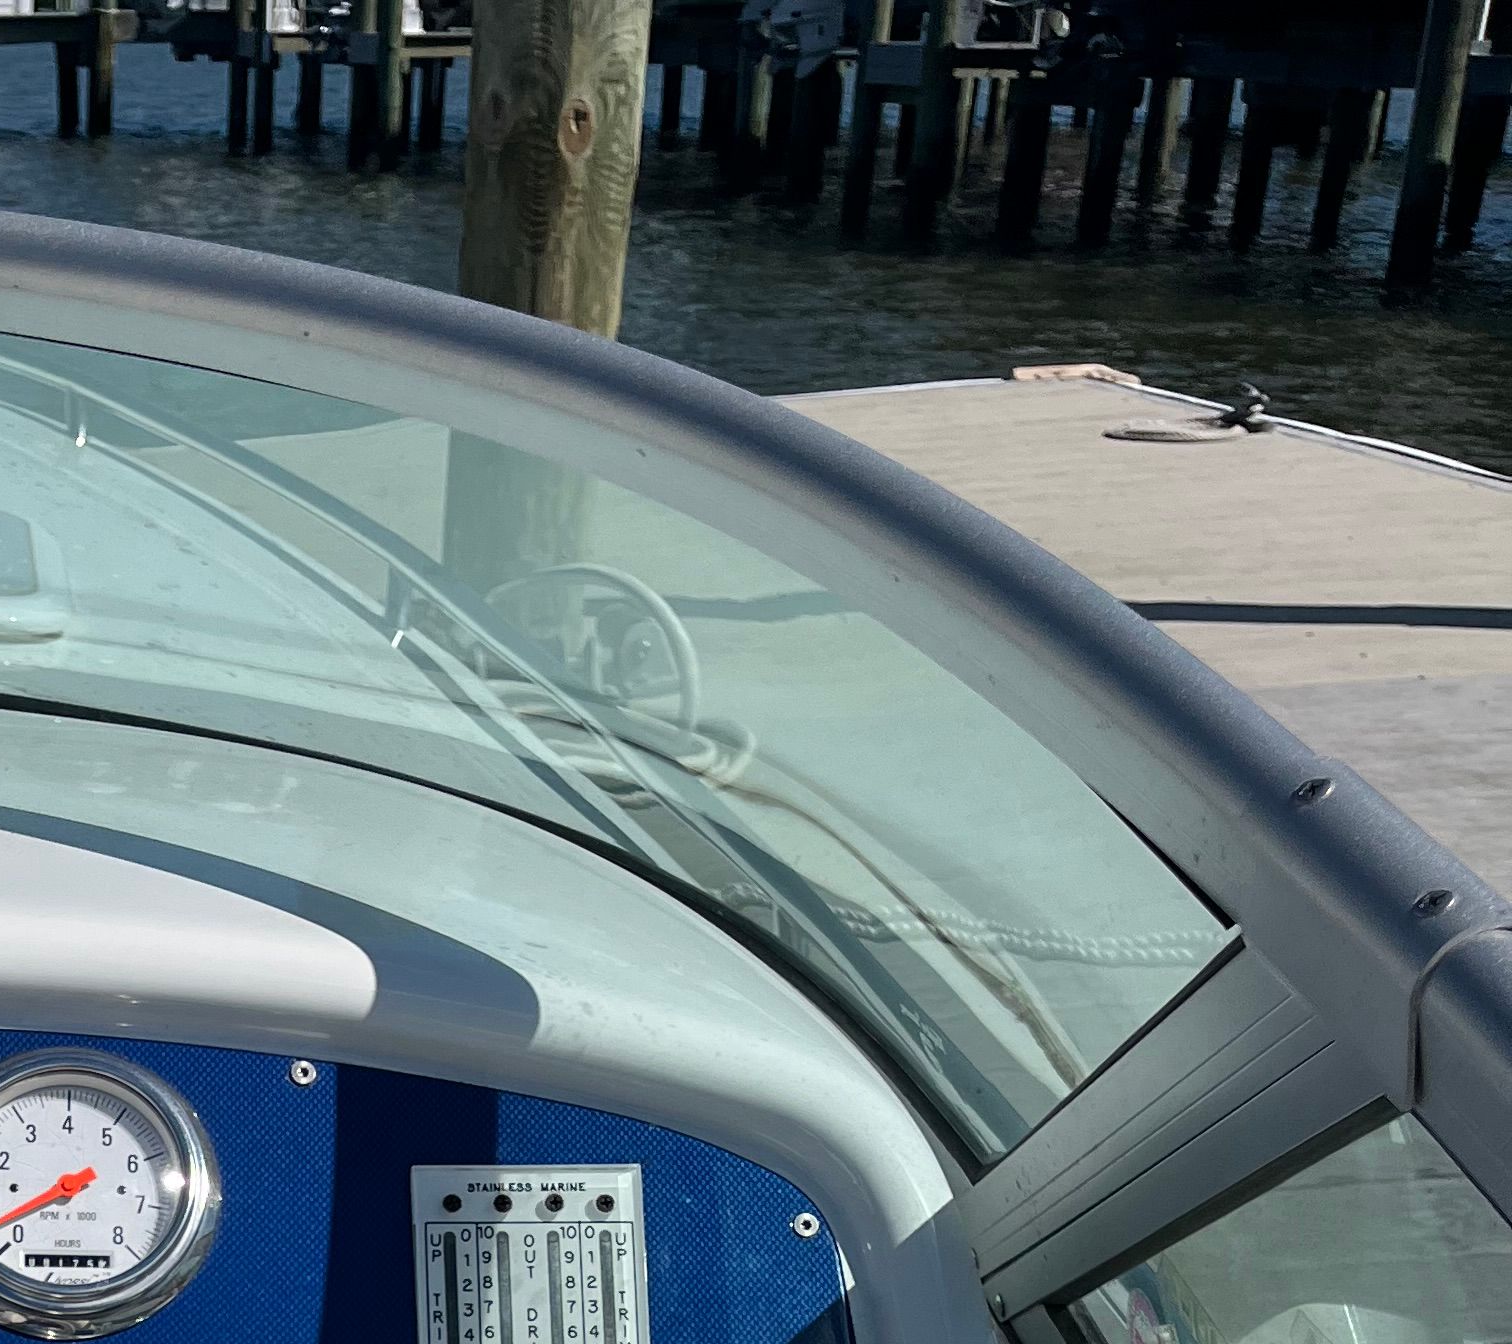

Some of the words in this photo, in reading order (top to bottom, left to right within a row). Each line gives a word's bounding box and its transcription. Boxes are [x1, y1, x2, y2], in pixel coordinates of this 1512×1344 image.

[468, 1183, 532, 1192] STAINLESS
[541, 1182, 586, 1192] MARINE
[40, 1212, 59, 1220] RPM
[77, 1212, 96, 1221] 1000
[461, 1229, 471, 1241] 0
[55, 1240, 81, 1248] HOURS
[431, 1235, 441, 1263] UP
[616, 1233, 626, 1261] UP
[524, 1235, 536, 1278] OUT
[463, 1279, 473, 1291] 2
[464, 1304, 473, 1316] 3
[465, 1329, 475, 1341] 4
